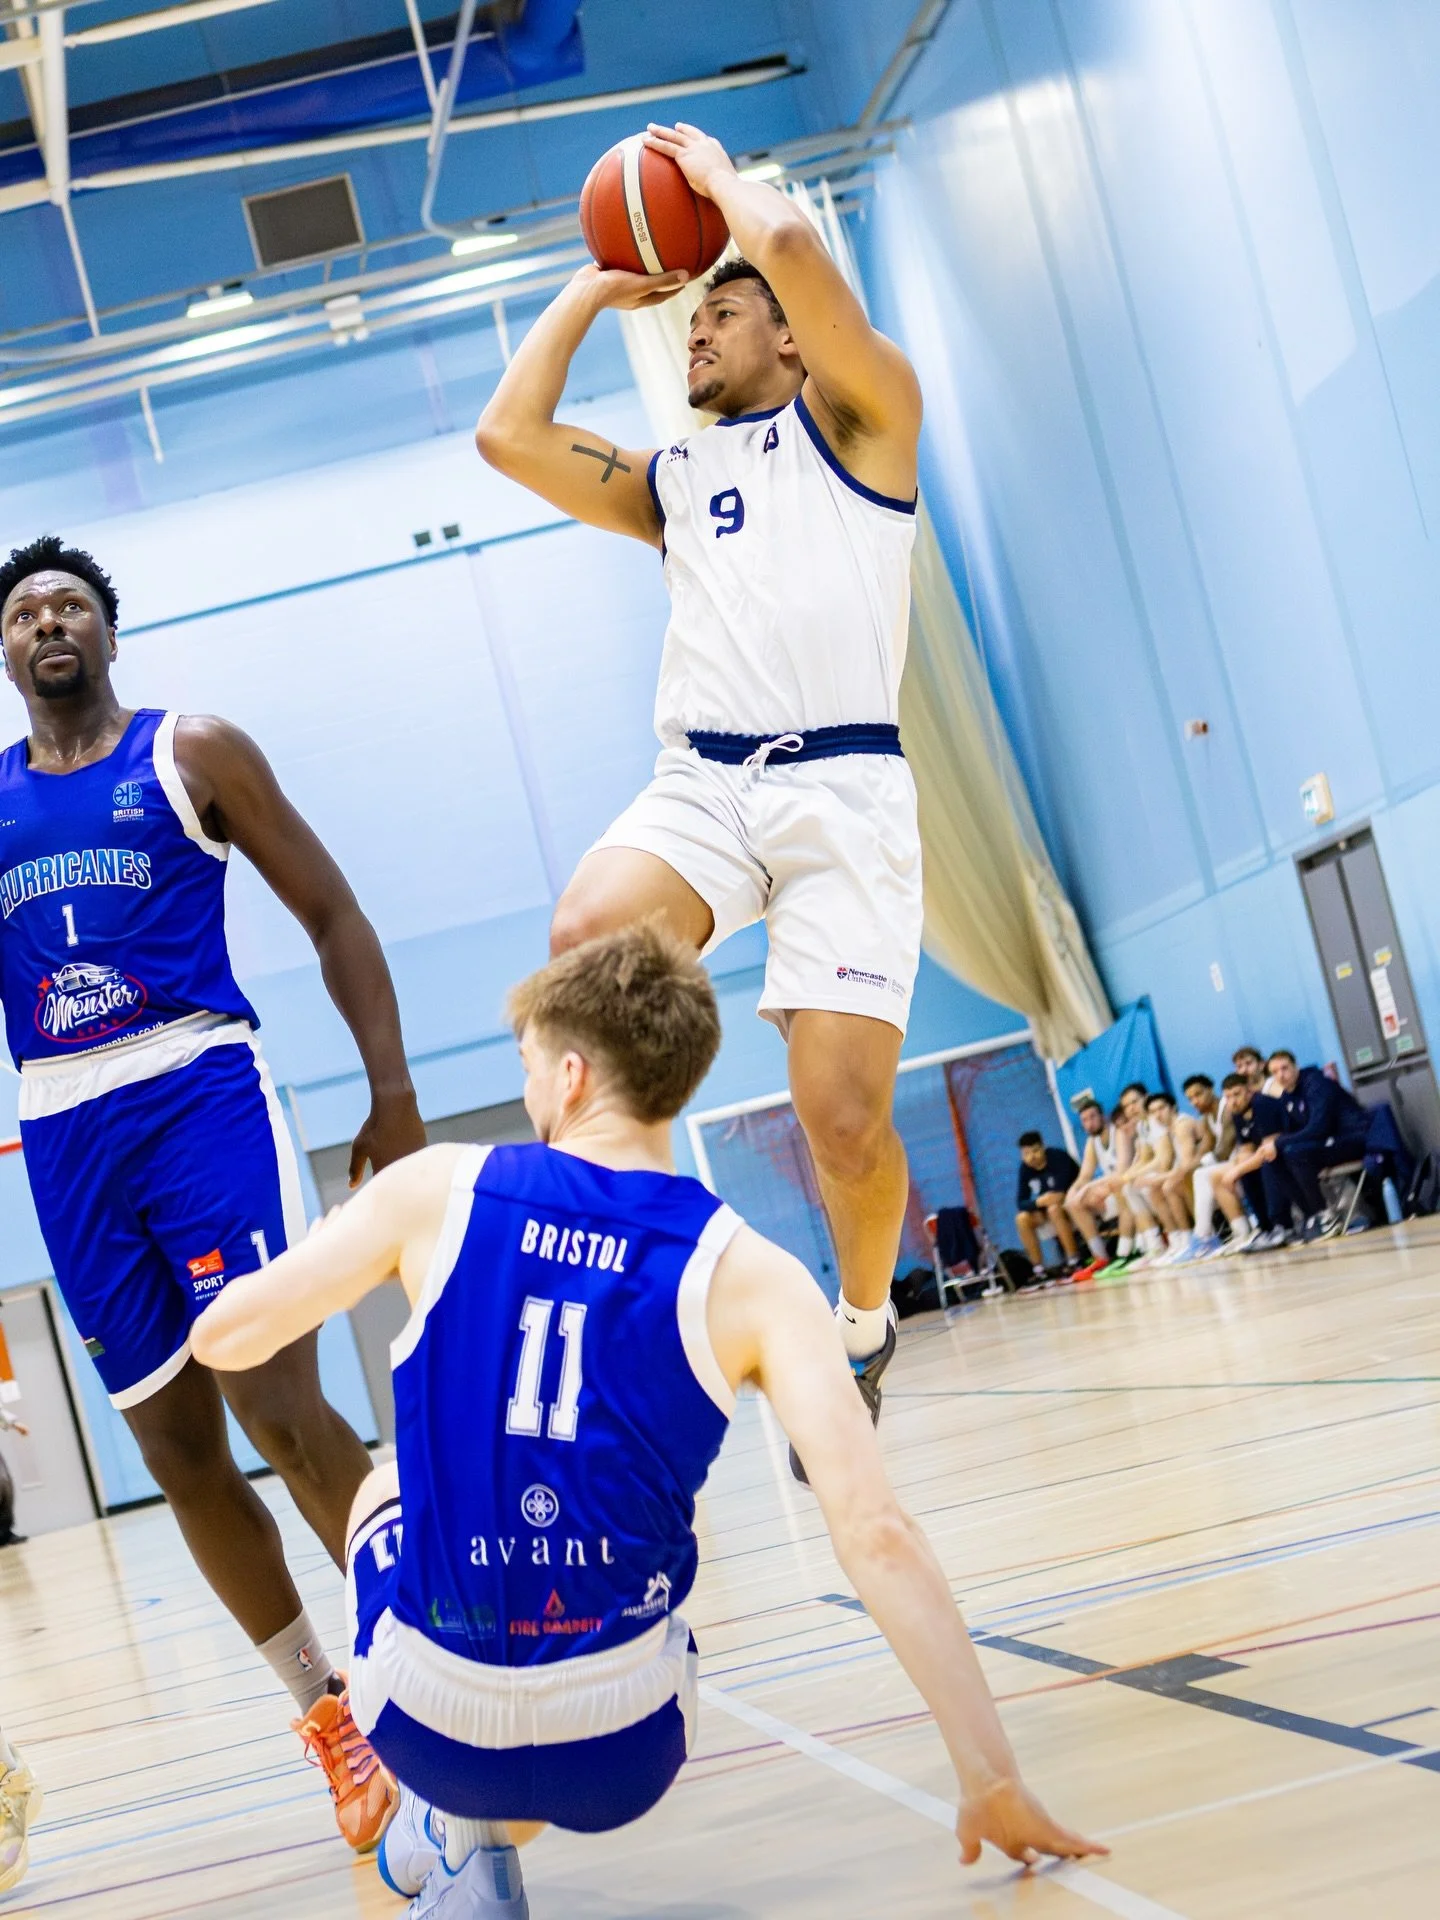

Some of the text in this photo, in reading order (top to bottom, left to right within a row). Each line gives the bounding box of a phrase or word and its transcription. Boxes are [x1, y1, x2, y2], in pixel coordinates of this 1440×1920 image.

[710, 487, 745, 538] 9
[113, 808, 144, 817] BRITISH
[0, 848, 152, 920] HURRICANES
[62, 904, 79, 947] 1
[848, 968, 888, 982] Newcastle
[43, 981, 138, 1036] Monster
[250, 1229, 271, 1269] 1
[520, 1218, 628, 1273] BRISTOL
[193, 1274, 224, 1293] SPORT
[505, 1295, 587, 1442] 11
[469, 1534, 615, 1567] avant
